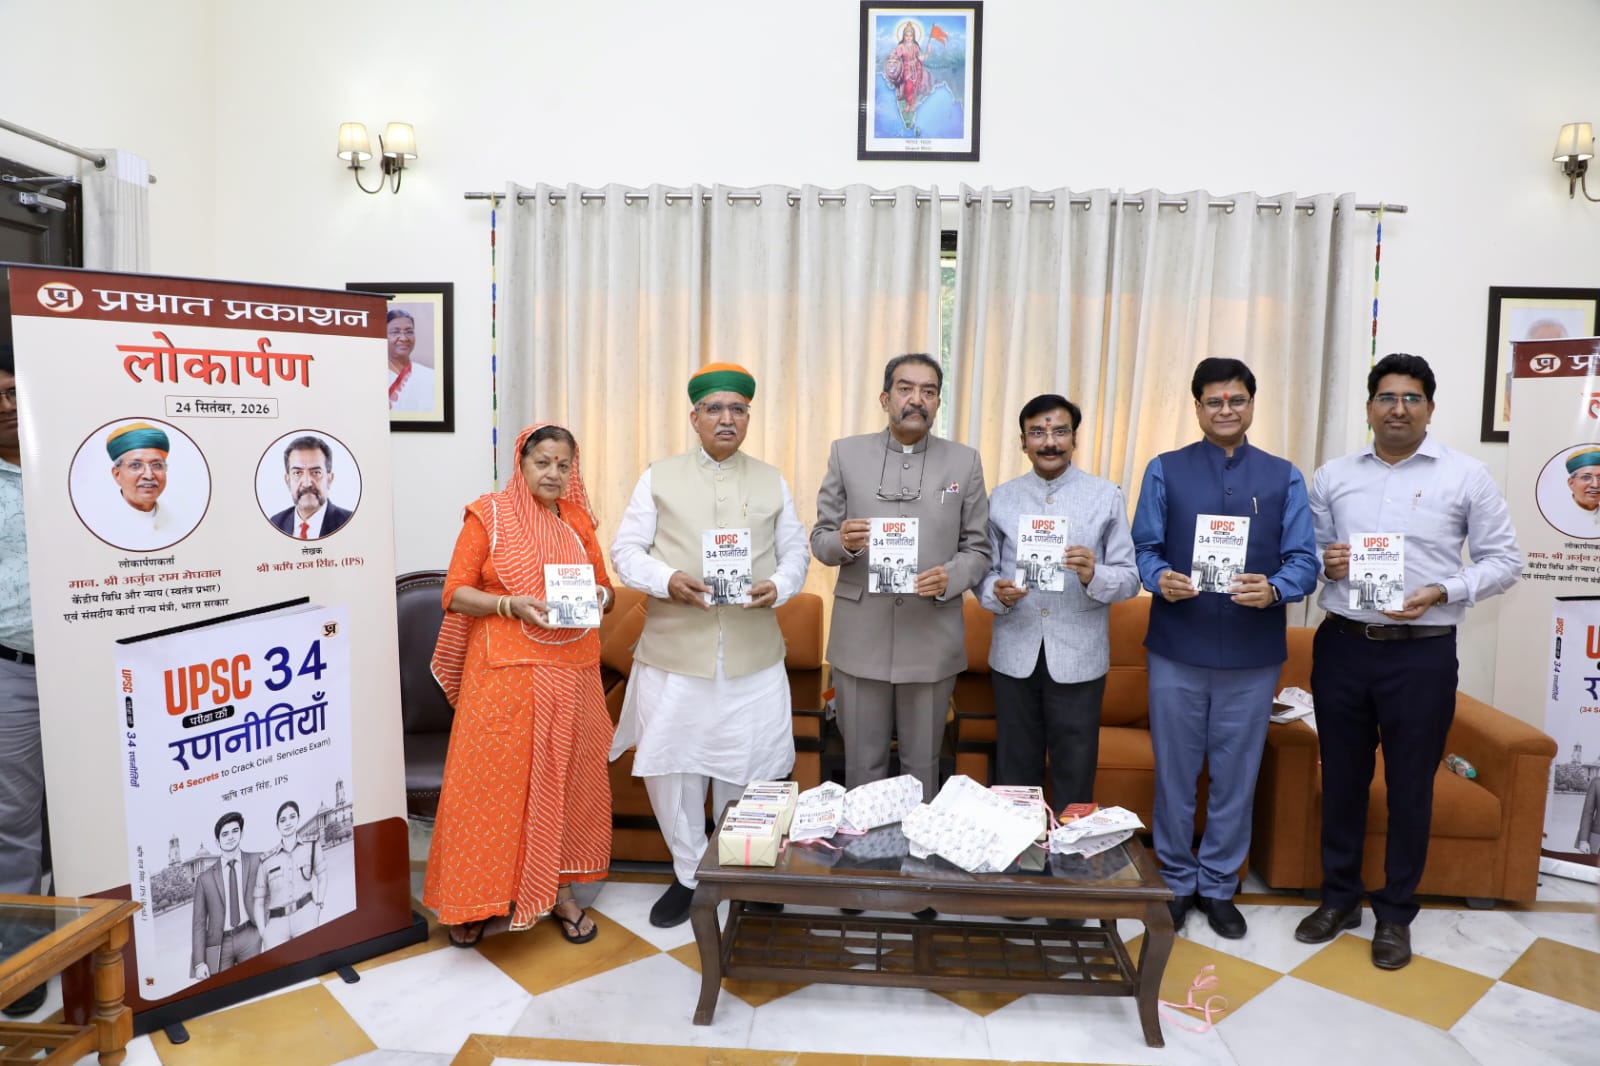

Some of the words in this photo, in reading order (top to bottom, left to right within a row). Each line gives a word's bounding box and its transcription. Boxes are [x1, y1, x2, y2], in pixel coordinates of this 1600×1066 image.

[92, 288, 213, 317] प्रभात
[221, 298, 370, 328] प्रकाशन
[116, 331, 315, 388] लोकार्पण
[175, 402, 191, 413] 24
[195, 399, 236, 415] सितंबर,
[240, 403, 270, 414] 2026
[882, 522, 906, 533] UPSC
[1031, 519, 1055, 530] UPSC
[1210, 519, 1235, 531] UPSC
[714, 533, 738, 545] UPSC
[1198, 535, 1210, 544] 34
[1363, 537, 1389, 548] UPSC
[301, 546, 323, 556] लेखक
[706, 550, 717, 559] 34
[117, 555, 176, 569] लोकार्पणकर्ता
[256, 561, 270, 573] श्री
[296, 560, 314, 570] राज
[341, 556, 365, 568] (IPS)
[68, 578, 100, 589] मान.
[103, 575, 119, 587] श्री
[122, 572, 156, 587] अर्जुन
[158, 571, 180, 583] राम
[183, 569, 222, 581] मेघवाल
[557, 567, 581, 576] UPSC
[71, 591, 100, 605] केंद्रीय
[101, 589, 122, 603] विधि
[125, 588, 142, 600] और
[143, 587, 164, 598] न्याय
[165, 584, 194, 597] (स्वतंत्र
[195, 582, 222, 594] प्रभार)
[63, 611, 79, 624] एवं
[81, 606, 113, 620] संसदीय
[115, 602, 136, 616] कार्य
[137, 603, 157, 614] राज्य
[158, 599, 178, 612] मंत्री,
[180, 599, 202, 610] भारत
[203, 596, 230, 609] सरकार
[121, 669, 133, 693] UPSC
[163, 653, 252, 716] UPSC
[263, 639, 328, 692] 34
[189, 711, 214, 726] परीक्षा
[214, 708, 229, 722] की
[168, 690, 329, 771] रणनीतियाँ
[126, 731, 137, 748] 34
[168, 781, 185, 794] (34
[186, 771, 220, 788] Secrets
[221, 768, 230, 777] to
[231, 760, 255, 774] Crack
[256, 755, 273, 767] Civil
[276, 747, 308, 761] Services
[309, 737, 331, 751] Exam)
[239, 786, 254, 796] राज
[274, 774, 290, 786] IPS
